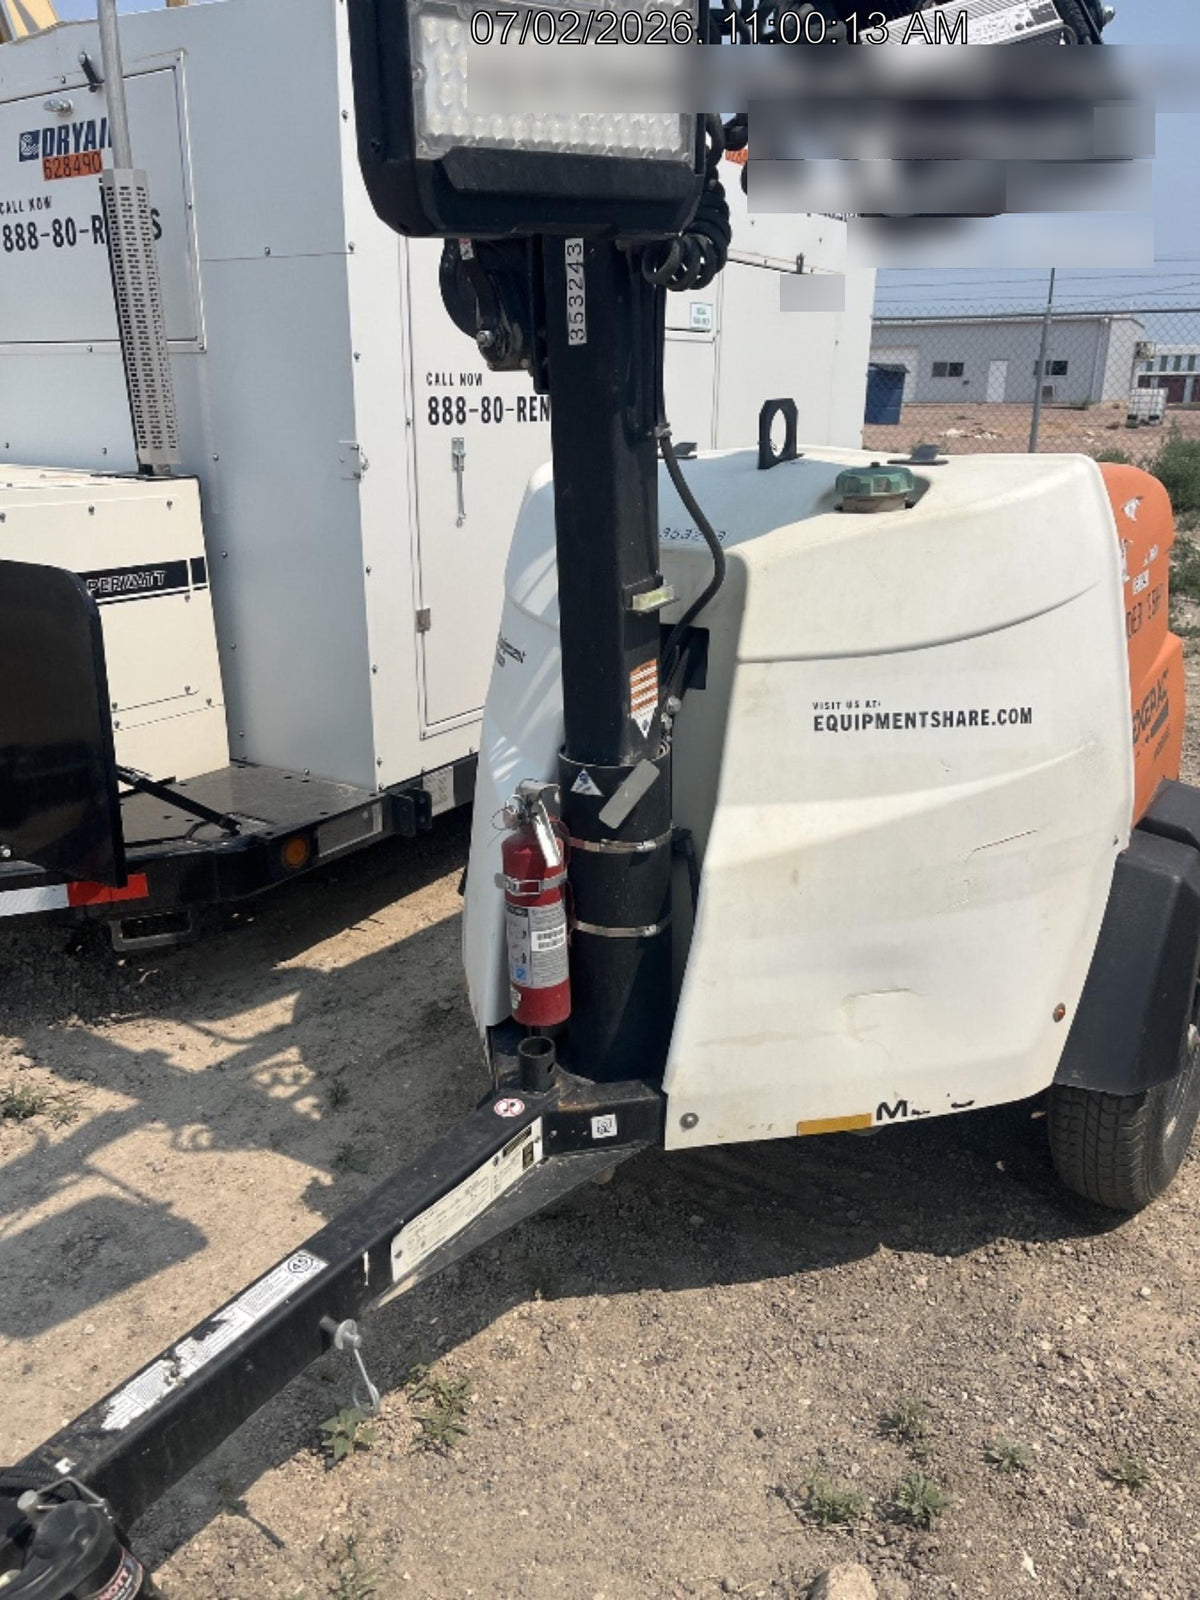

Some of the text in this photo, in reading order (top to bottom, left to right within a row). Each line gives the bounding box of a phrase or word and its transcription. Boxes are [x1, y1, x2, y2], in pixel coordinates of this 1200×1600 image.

[43, 151, 102, 180] 628490
[0, 196, 52, 215] CALL NOW
[2, 208, 162, 253] 888-80-RS
[566, 242, 584, 341] 353243
[426, 372, 483, 387] CALL NOW
[427, 395, 551, 426] 888-80-REN
[86, 569, 167, 597] PERWATT
[812, 701, 842, 711] VISIT
[846, 700, 860, 709] US
[813, 706, 1033, 733] EQUIPMENTSHARE.COM
